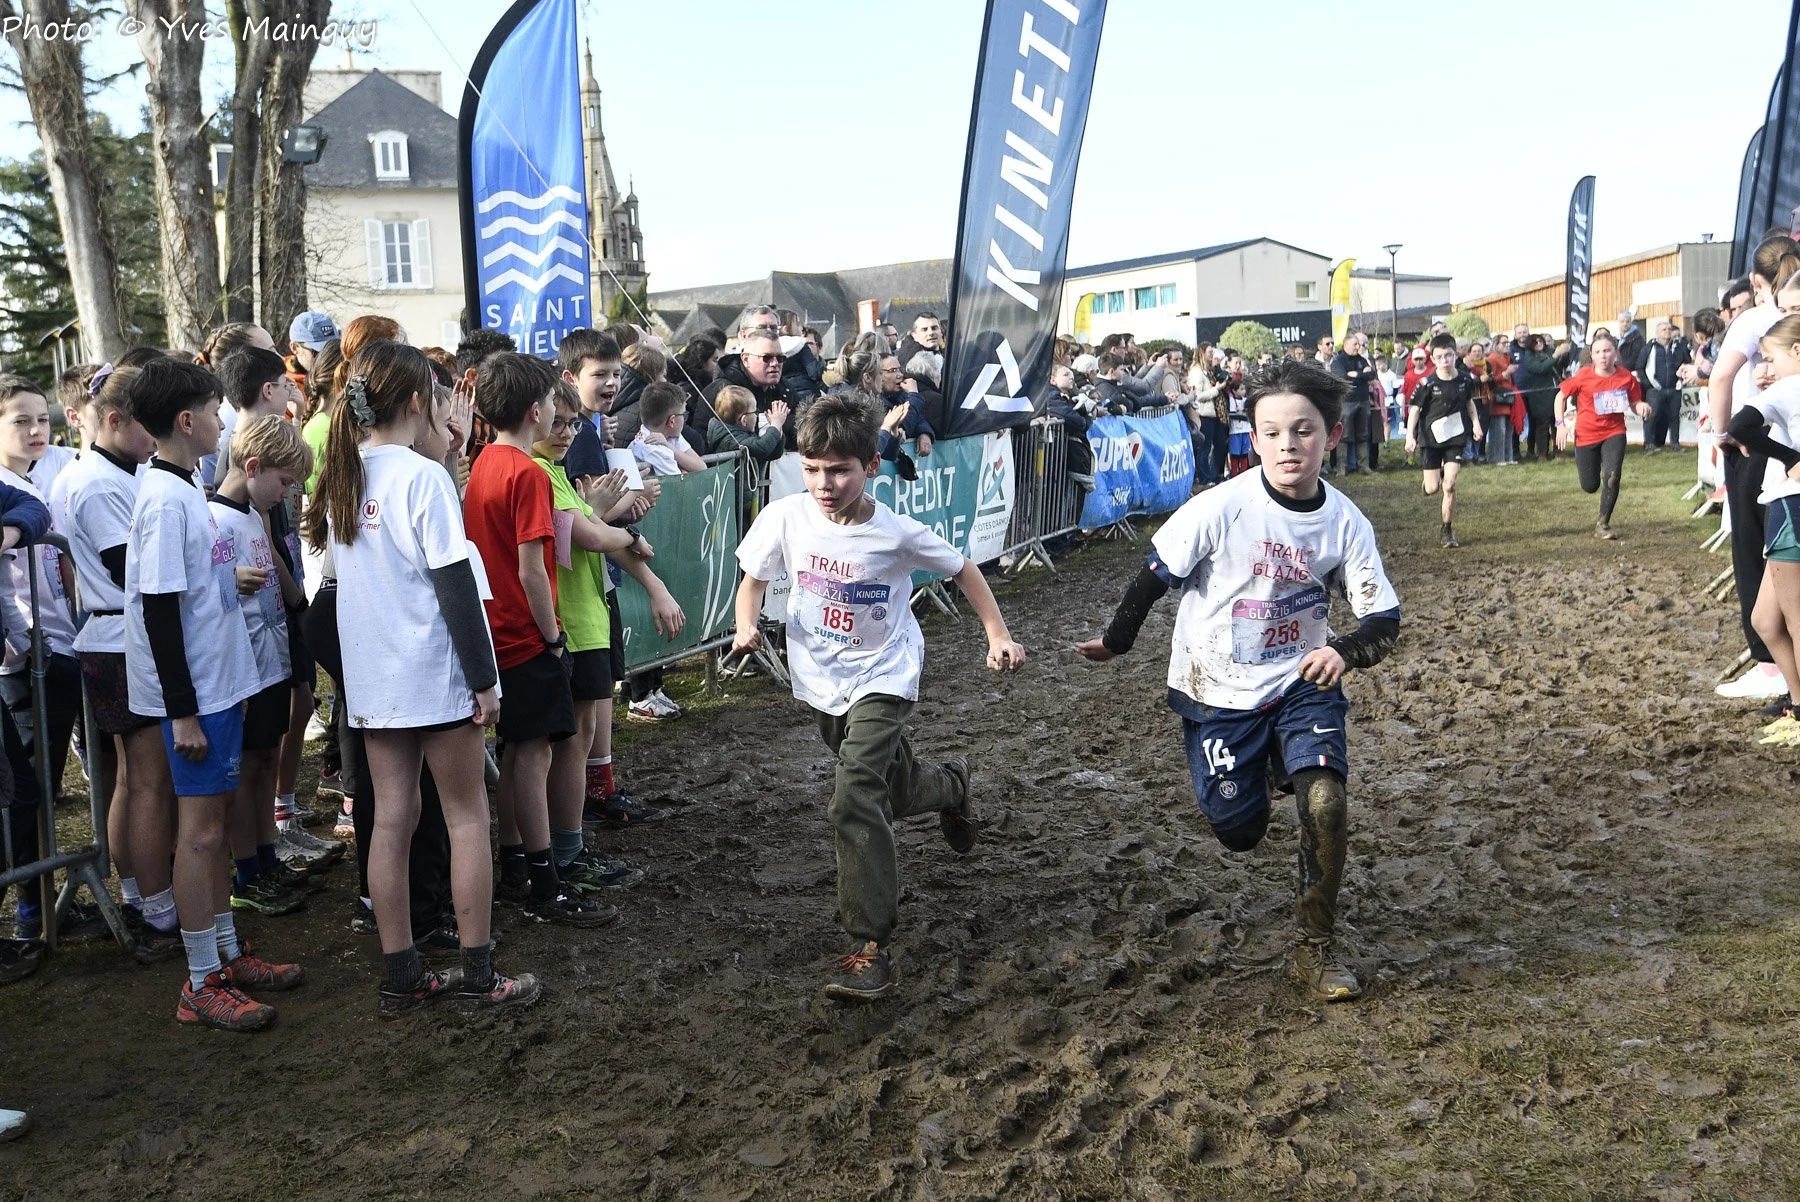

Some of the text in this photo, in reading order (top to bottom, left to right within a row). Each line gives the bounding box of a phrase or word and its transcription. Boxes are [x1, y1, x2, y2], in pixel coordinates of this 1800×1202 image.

[486, 295, 585, 328] SAINT
[1263, 541, 1307, 564] TRAIL
[810, 554, 853, 578] TRAIL
[1253, 563, 1309, 581] GLAZIG
[811, 582, 887, 602] GLAZIG KINDER
[1249, 592, 1325, 619] GLAZIG KINDER
[823, 606, 855, 633] 185
[814, 626, 849, 644] SUPER
[1264, 620, 1300, 648] 258
[1260, 645, 1297, 661] SUPER
[1203, 738, 1236, 776] 14
